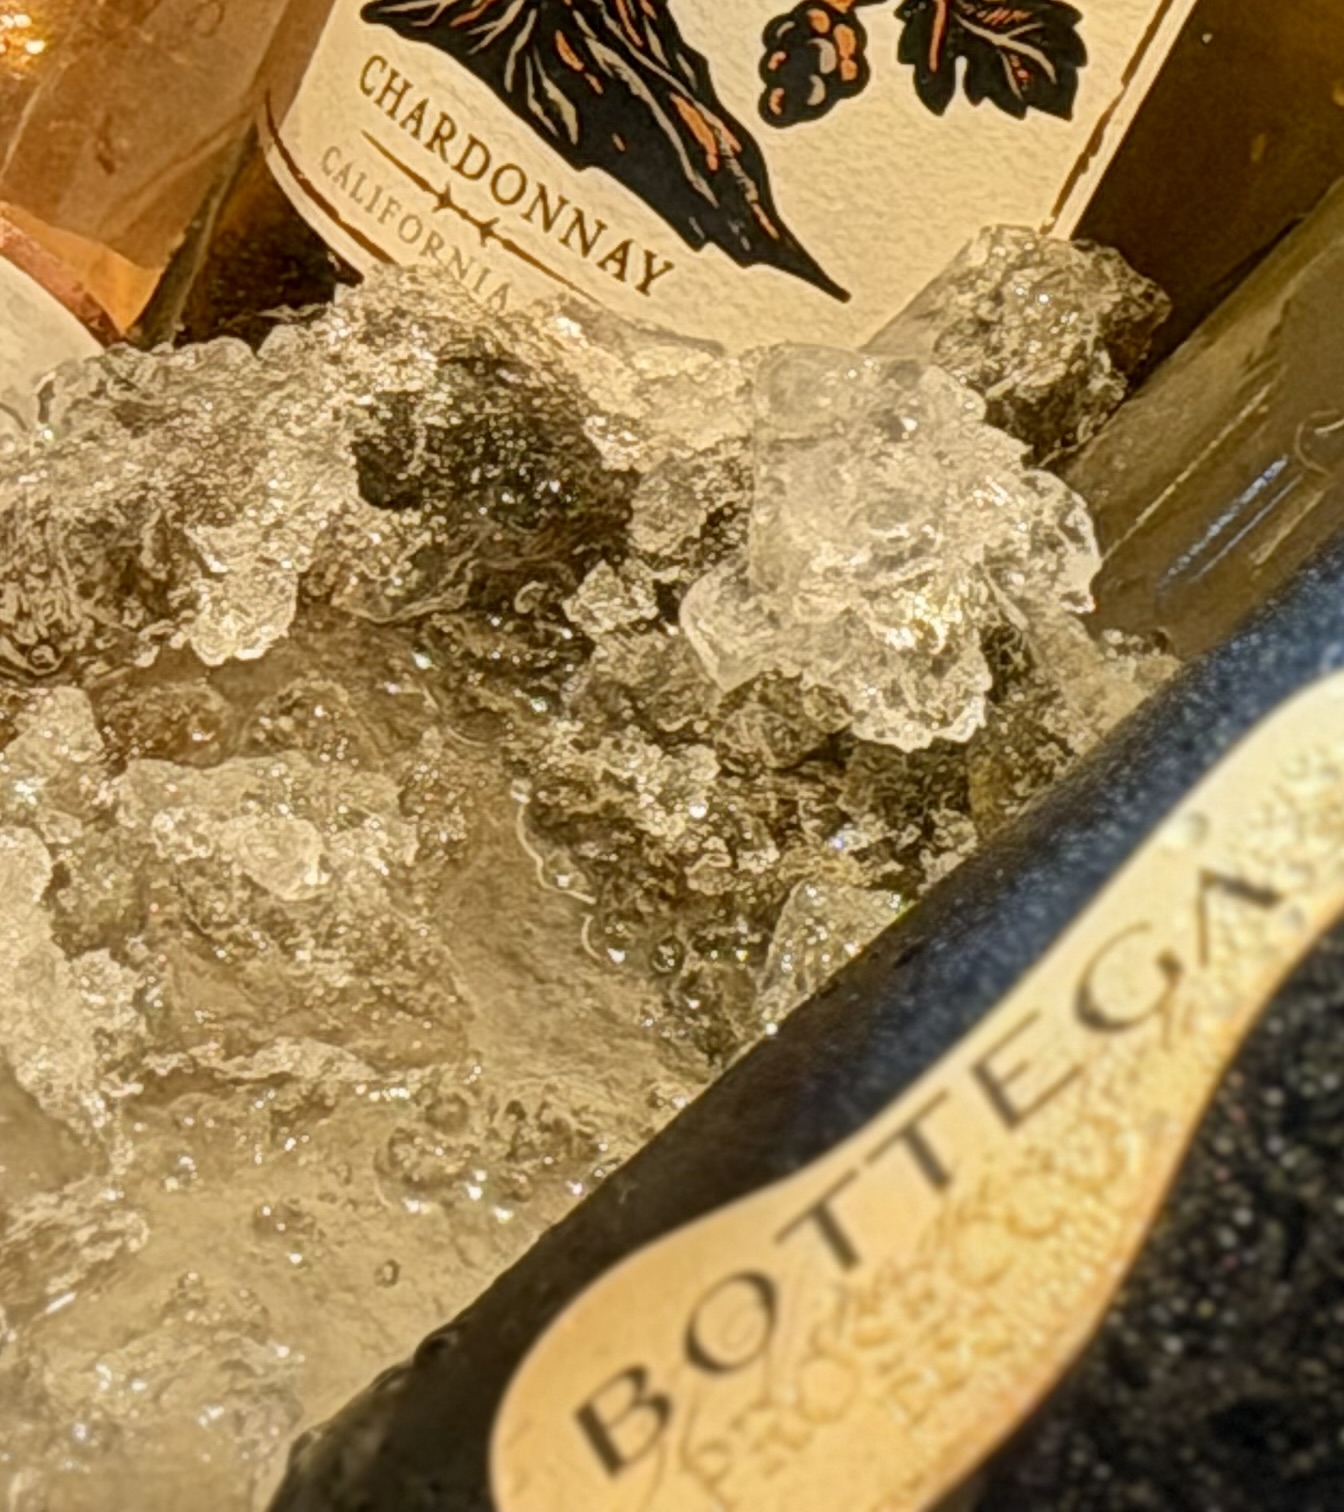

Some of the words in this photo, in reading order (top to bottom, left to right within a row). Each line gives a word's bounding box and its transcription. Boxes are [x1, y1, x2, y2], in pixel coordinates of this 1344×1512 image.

[320, 144, 512, 310] CALIFORNIA
[359, 54, 674, 297] CHARDONNAY
[572, 870, 1283, 1480] BOTTEGA
